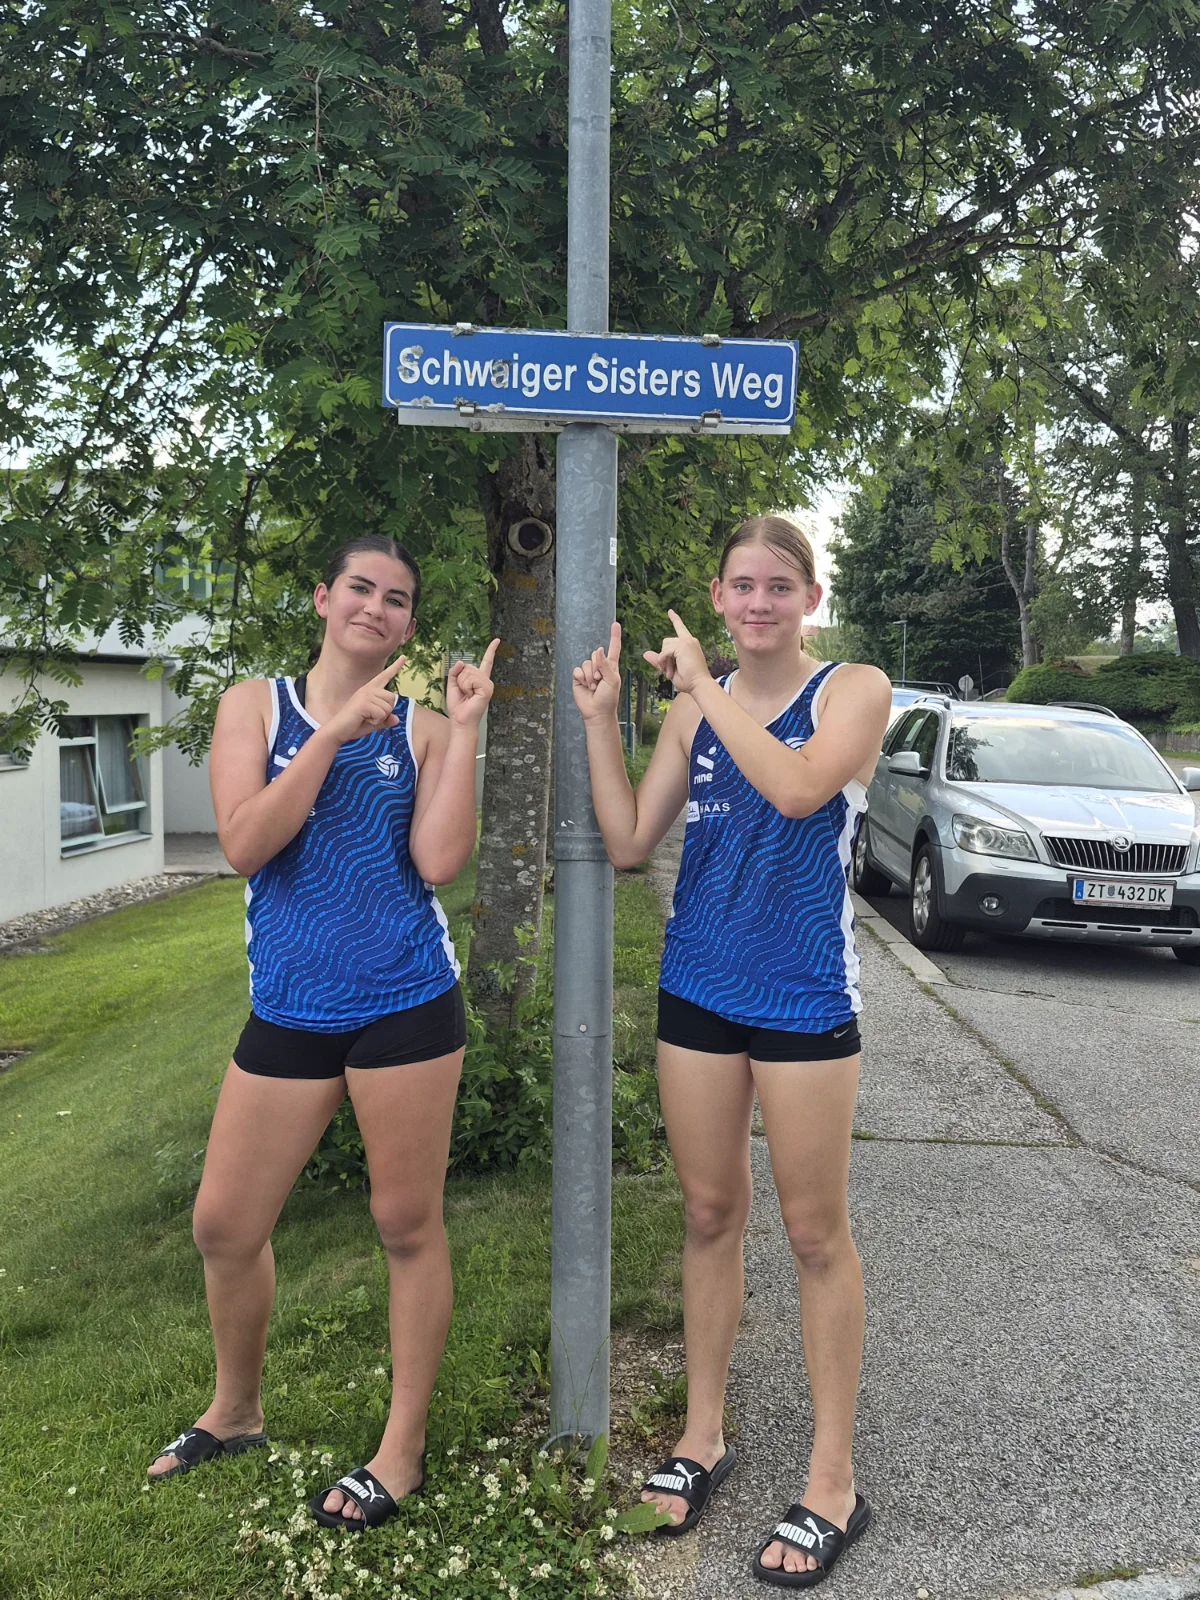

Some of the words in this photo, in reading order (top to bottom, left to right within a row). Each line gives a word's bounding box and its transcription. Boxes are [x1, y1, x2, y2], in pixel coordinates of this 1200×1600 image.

[397, 345, 577, 398] Schwaiger
[587, 354, 701, 397] Sisters
[710, 362, 784, 408] Weg
[694, 773, 713, 784] nine
[1087, 883, 1106, 898] ZT
[647, 1473, 686, 1491] PUMA
[773, 1522, 817, 1549] PUMA
